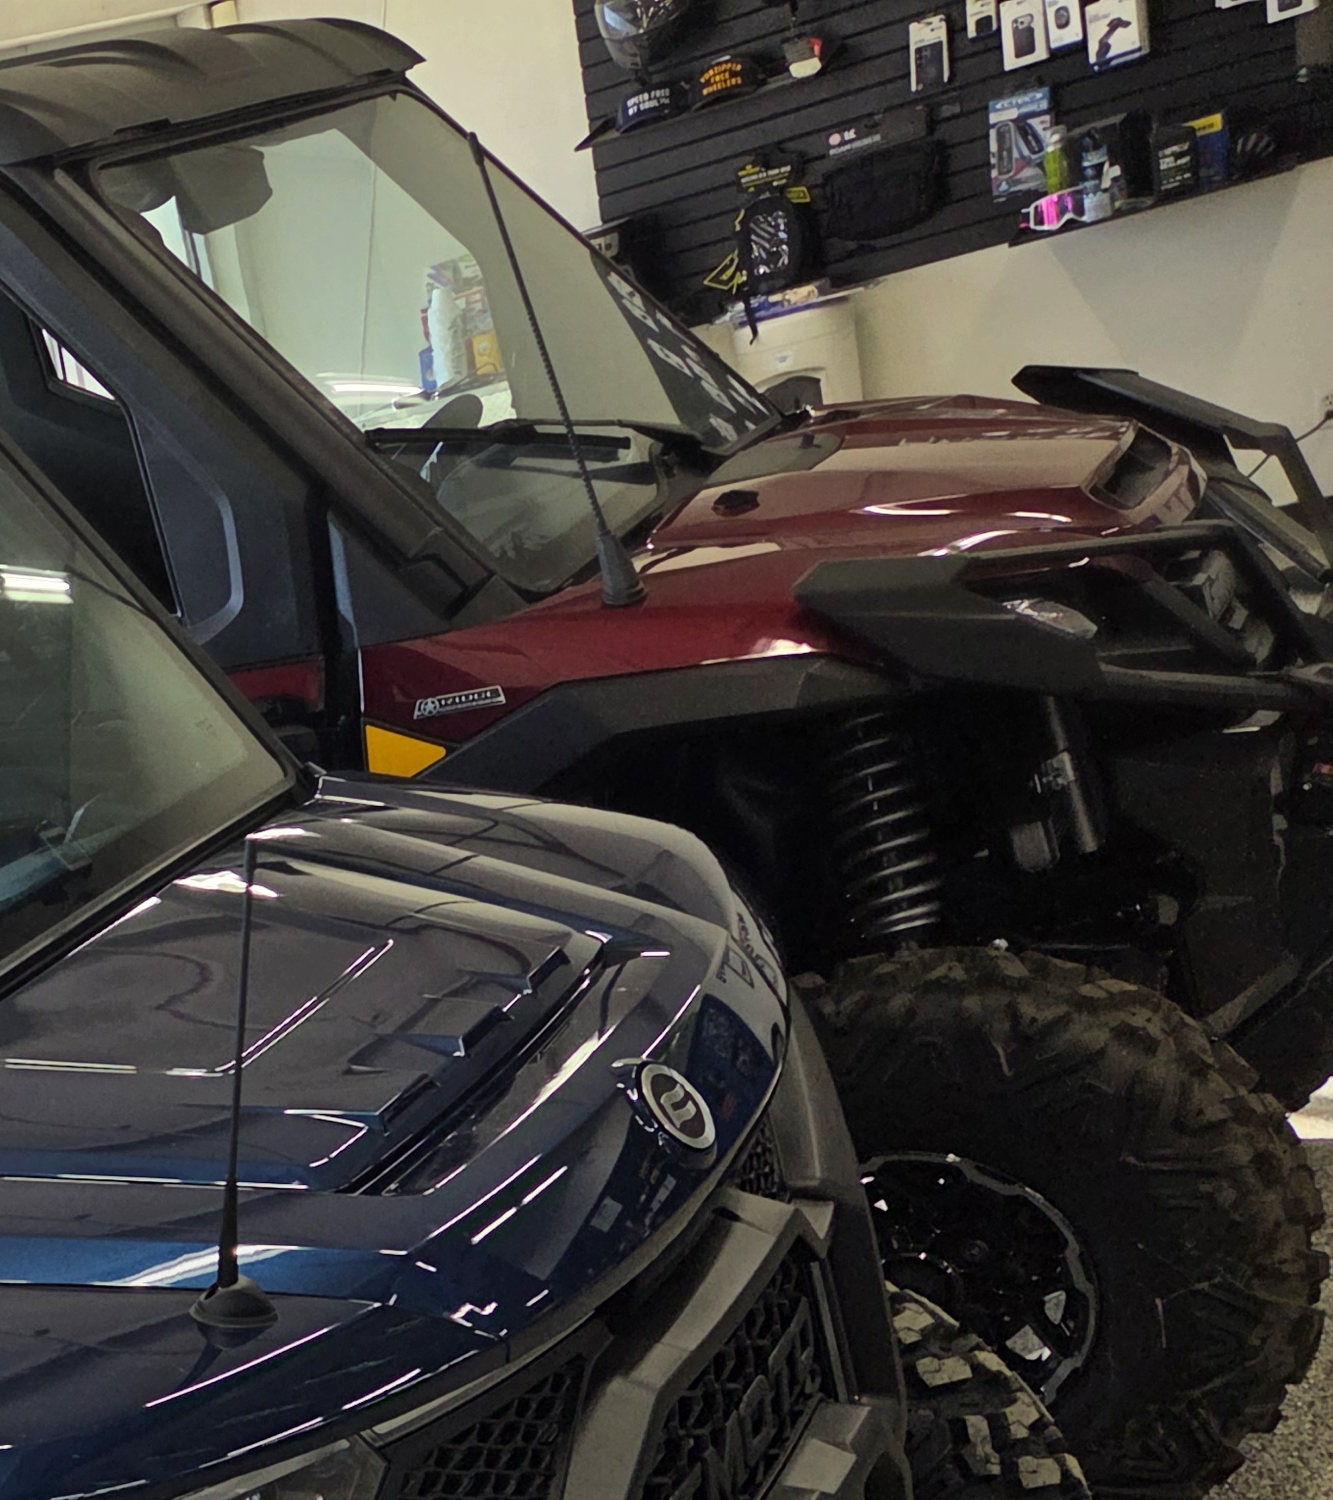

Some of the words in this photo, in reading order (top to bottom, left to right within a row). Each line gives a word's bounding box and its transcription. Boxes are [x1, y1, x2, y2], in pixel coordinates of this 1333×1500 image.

[702, 76, 742, 96] WHEELERS
[710, 71, 730, 84] FREE
[627, 91, 649, 107] SPEED
[650, 88, 670, 99] FREE
